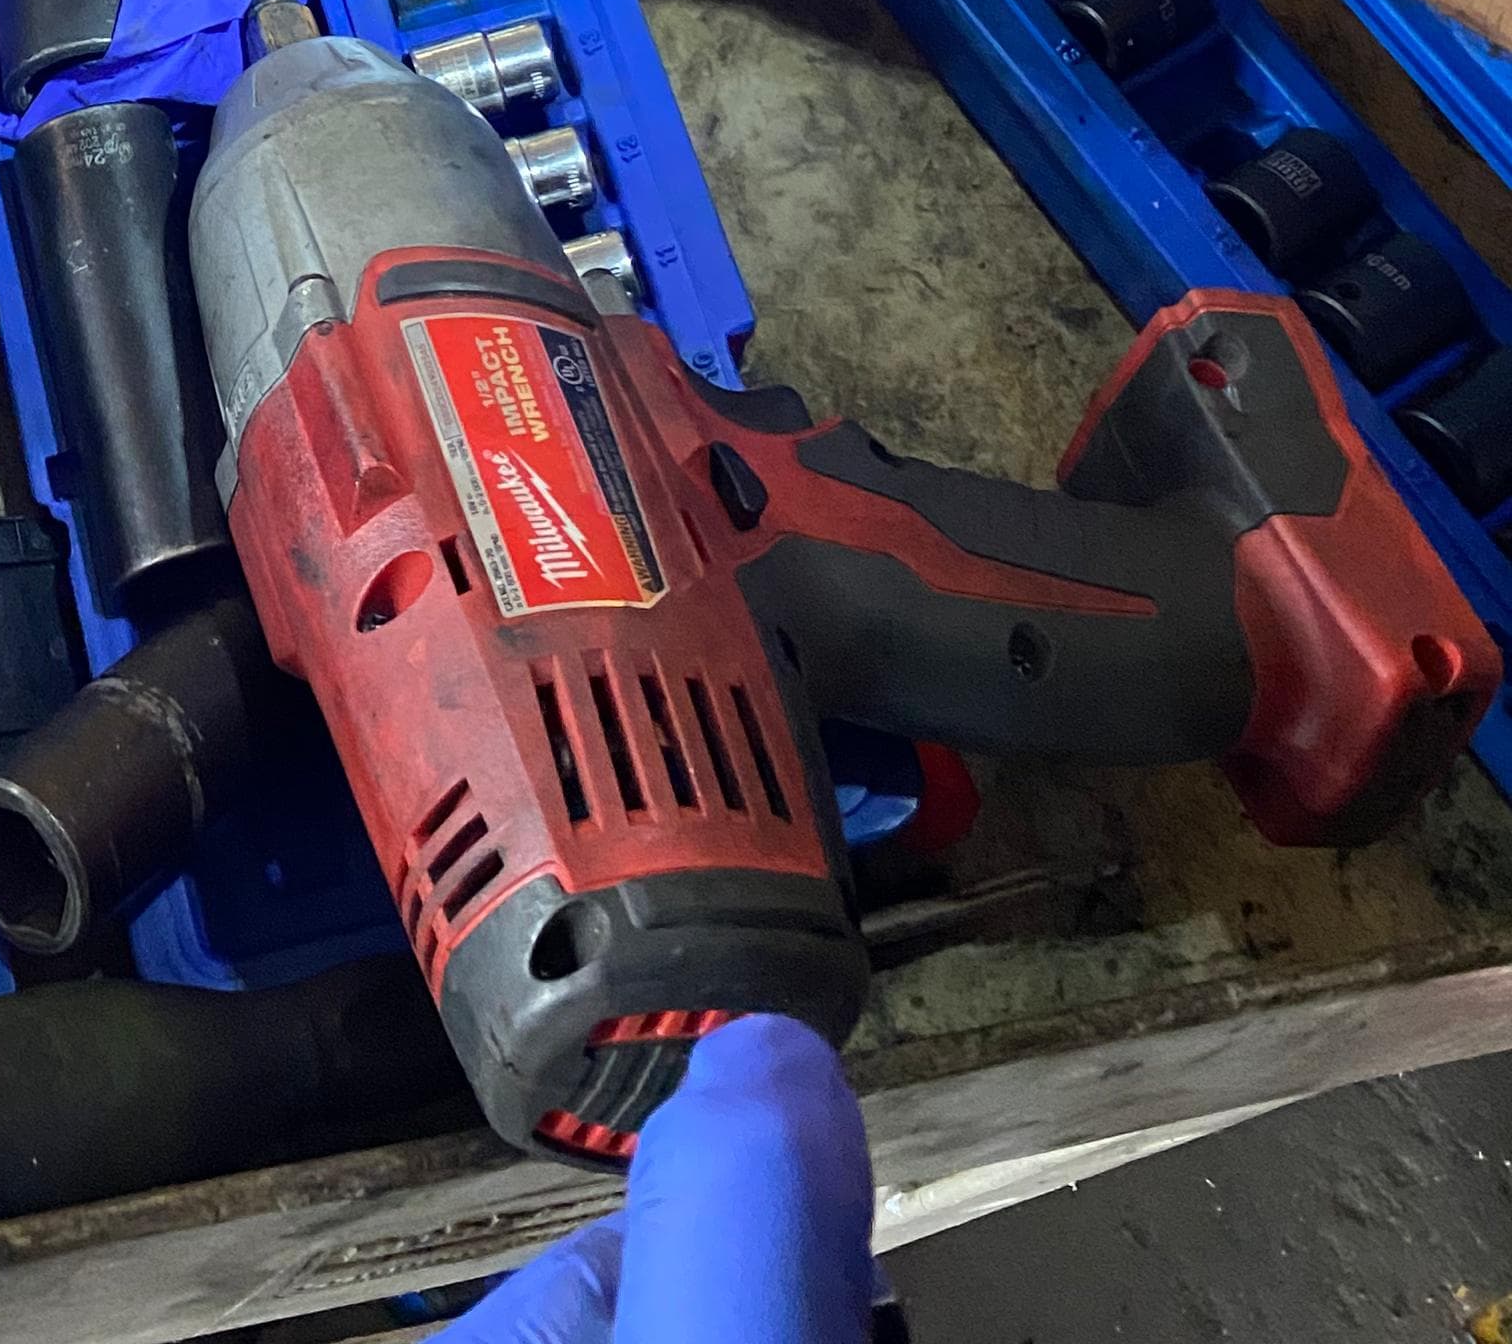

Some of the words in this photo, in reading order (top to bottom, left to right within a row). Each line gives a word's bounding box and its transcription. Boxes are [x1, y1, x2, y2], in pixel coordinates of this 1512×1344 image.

[578, 32, 604, 57] 13
[83, 147, 106, 169] 24
[617, 135, 643, 164] 12
[654, 243, 679, 268] 11
[475, 336, 526, 437] IMPACT
[493, 325, 550, 443] WRENCH
[691, 351, 722, 388] 10
[472, 369, 493, 410] 1/2"
[490, 451, 590, 590] Milwaukee
